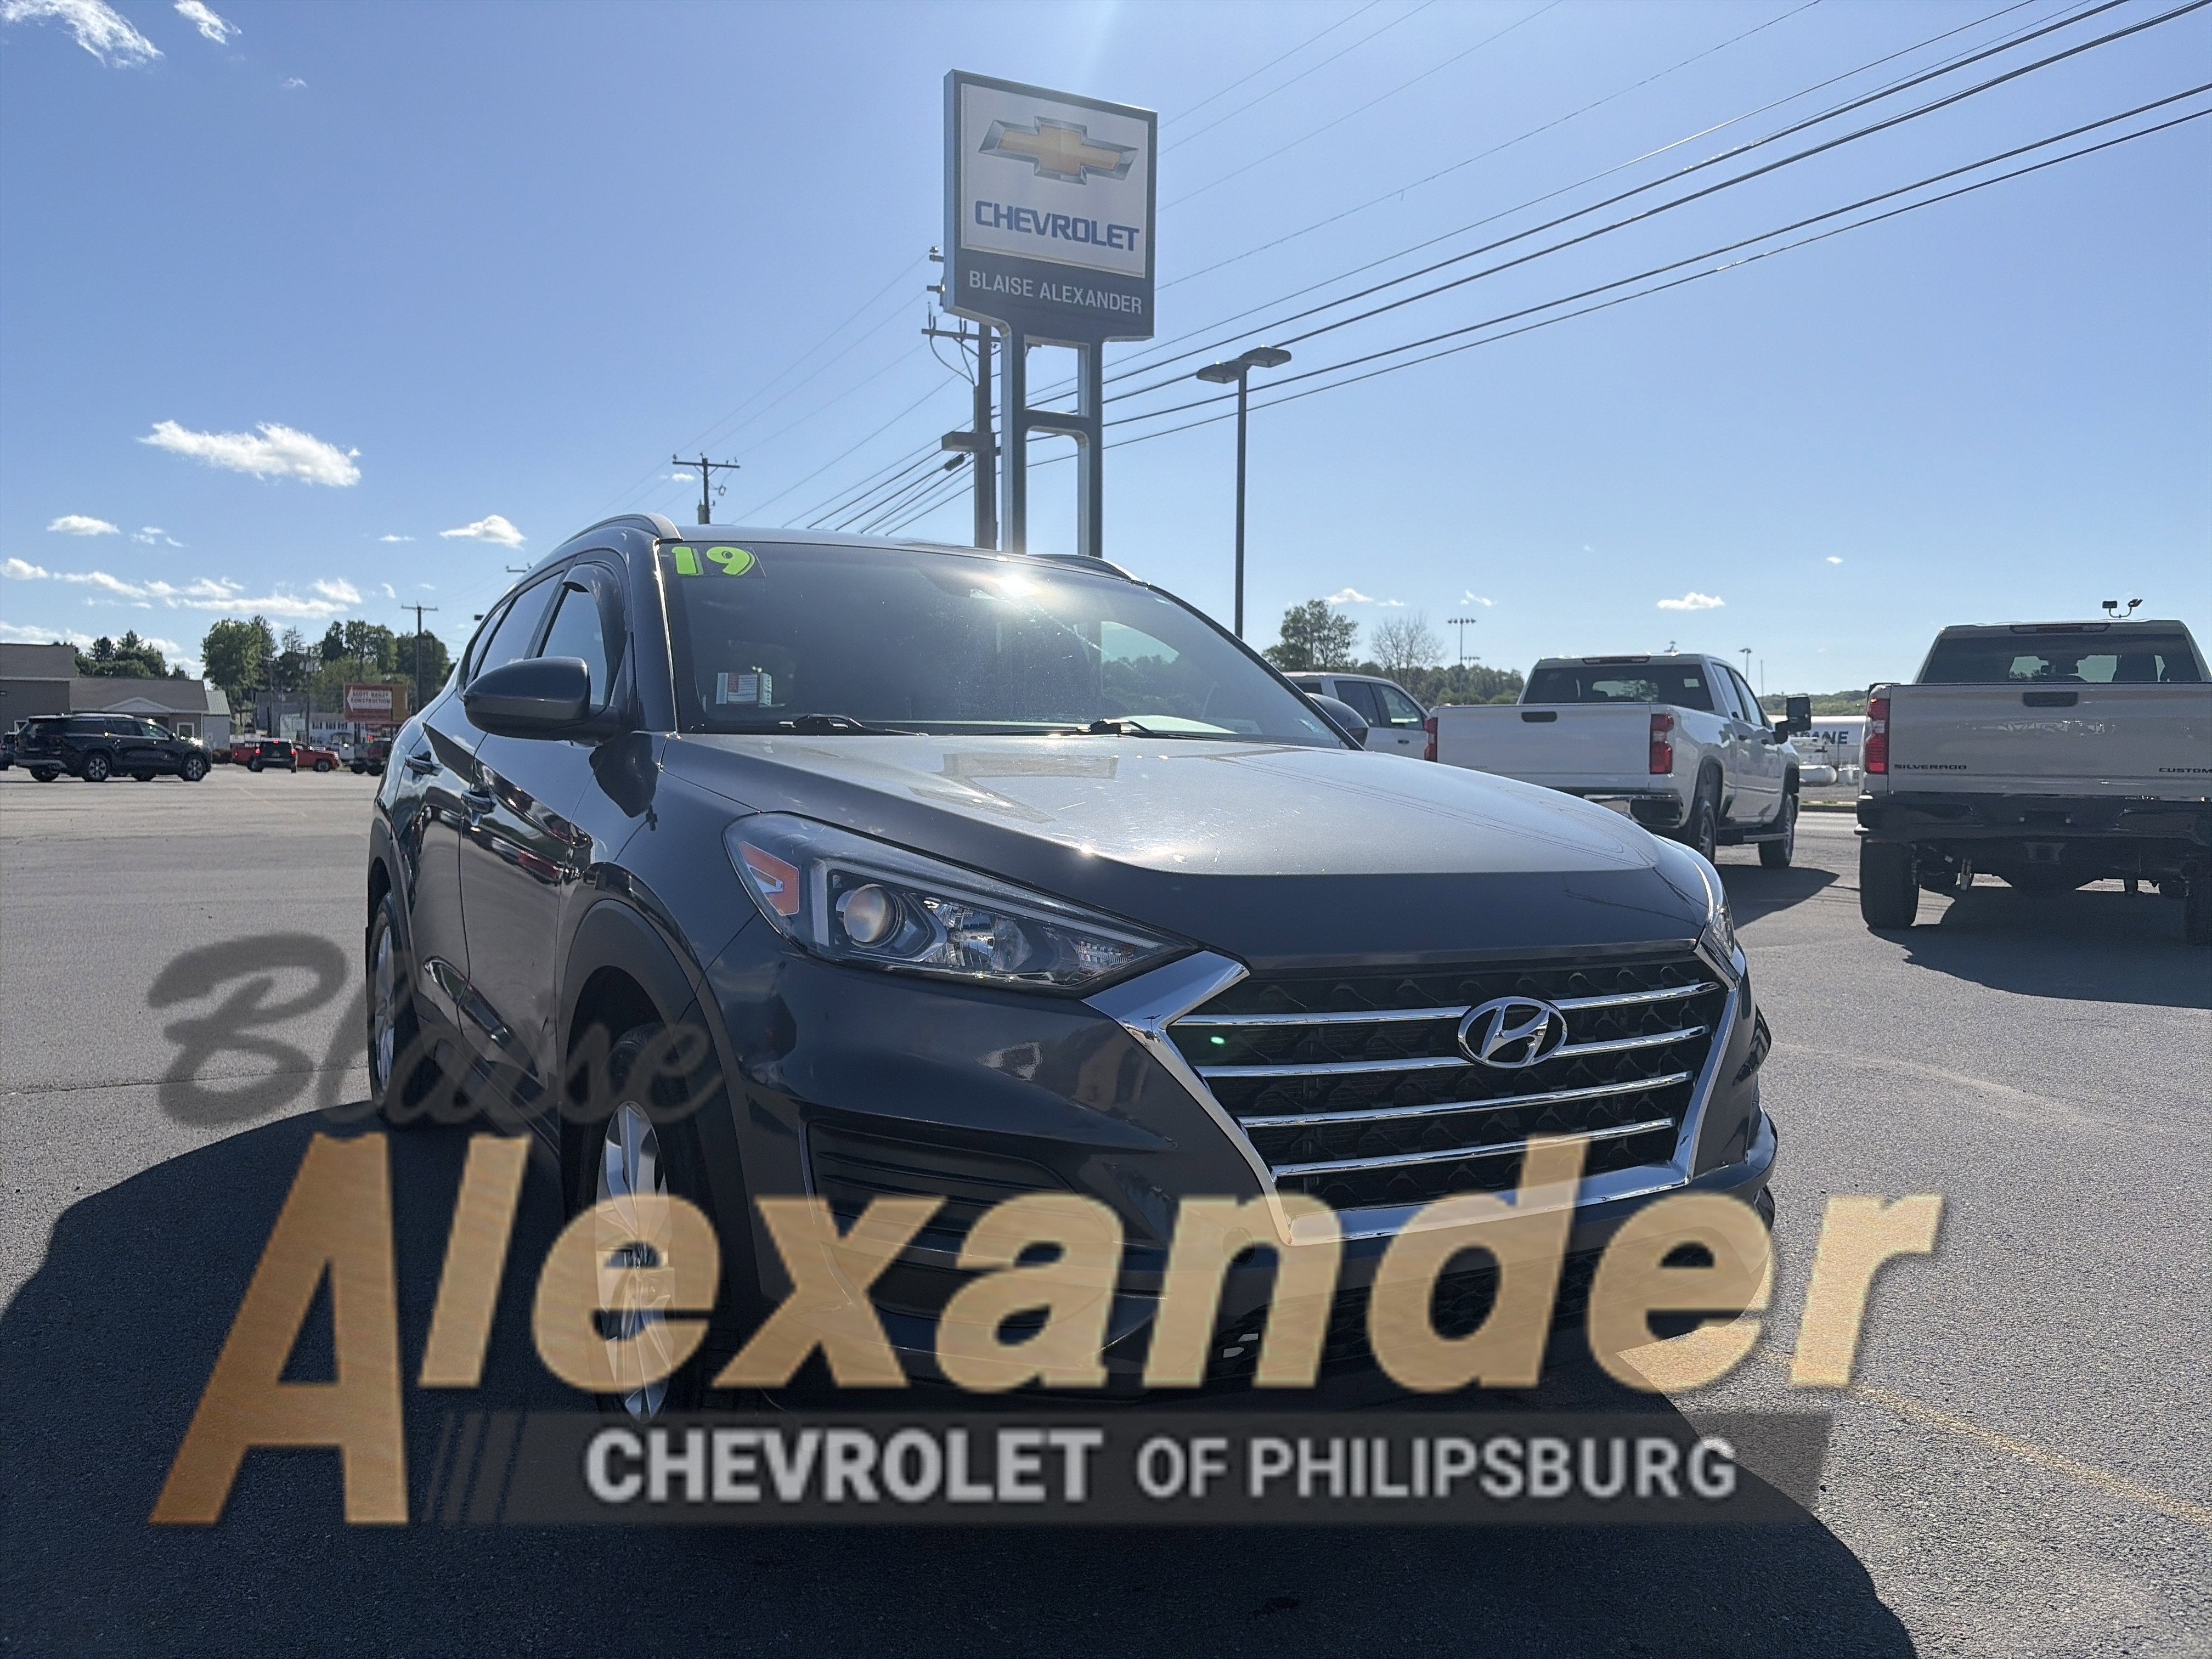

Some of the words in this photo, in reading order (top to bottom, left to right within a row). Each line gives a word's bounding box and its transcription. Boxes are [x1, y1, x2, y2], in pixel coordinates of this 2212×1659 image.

[975, 200, 1139, 251] CHEVROLET
[969, 270, 1034, 297] BLAISE
[1039, 282, 1142, 315] ALEXANDER
[672, 546, 755, 576] 19
